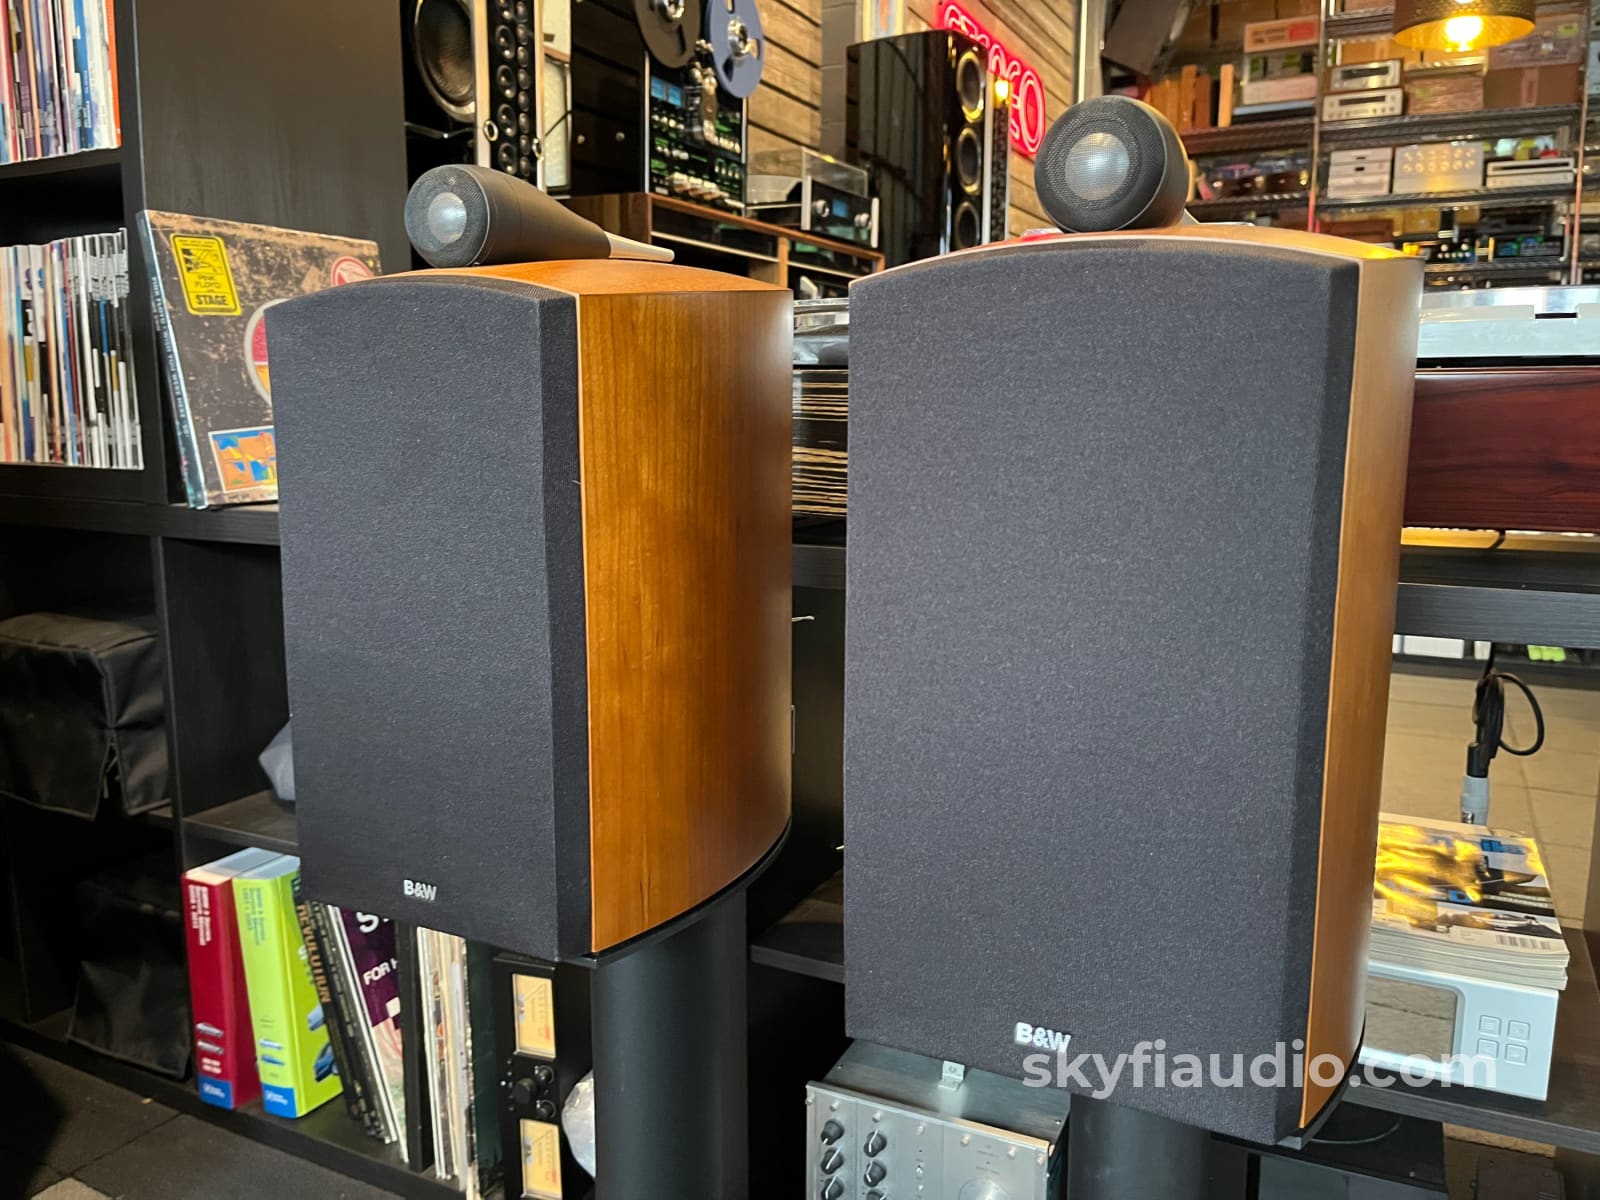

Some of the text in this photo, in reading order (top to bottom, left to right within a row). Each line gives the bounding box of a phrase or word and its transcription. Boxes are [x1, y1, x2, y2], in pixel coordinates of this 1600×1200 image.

[196, 294, 229, 306] STAGE
[403, 879, 437, 901] B&W
[363, 961, 391, 986] FOR
[1016, 1021, 1072, 1052] B&W
